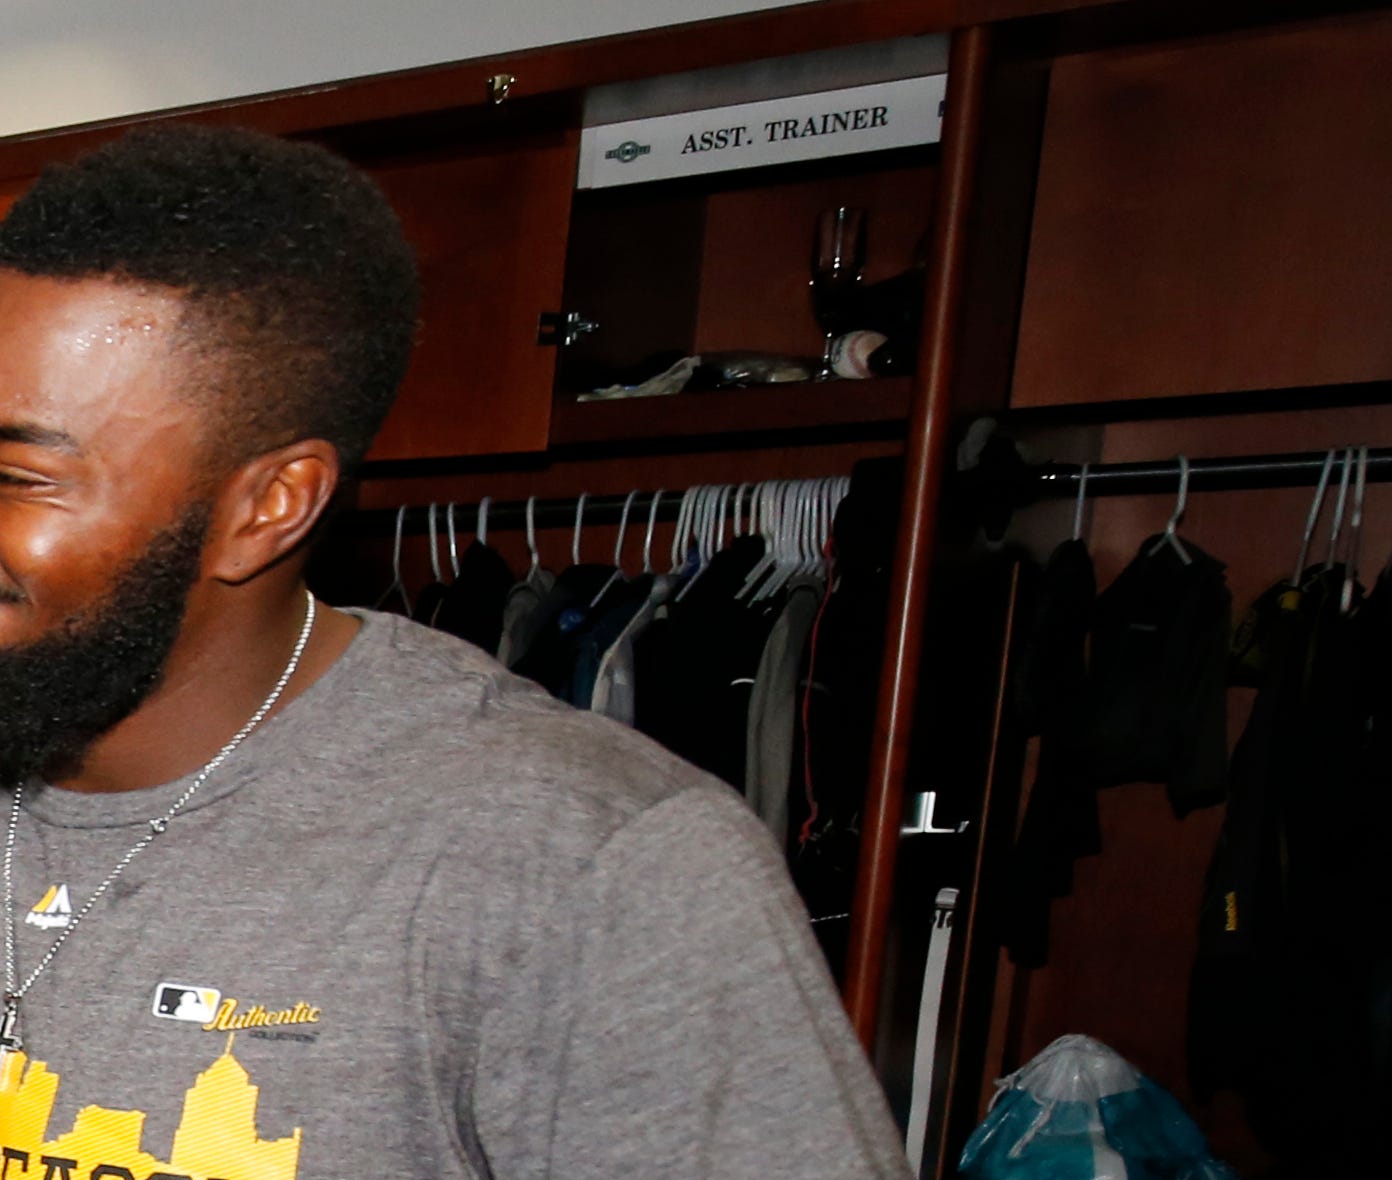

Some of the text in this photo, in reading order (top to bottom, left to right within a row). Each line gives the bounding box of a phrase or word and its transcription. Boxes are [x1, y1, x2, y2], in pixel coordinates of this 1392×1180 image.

[681, 106, 889, 155] ASST. TRAINER
[203, 998, 322, 1031] Authentic
